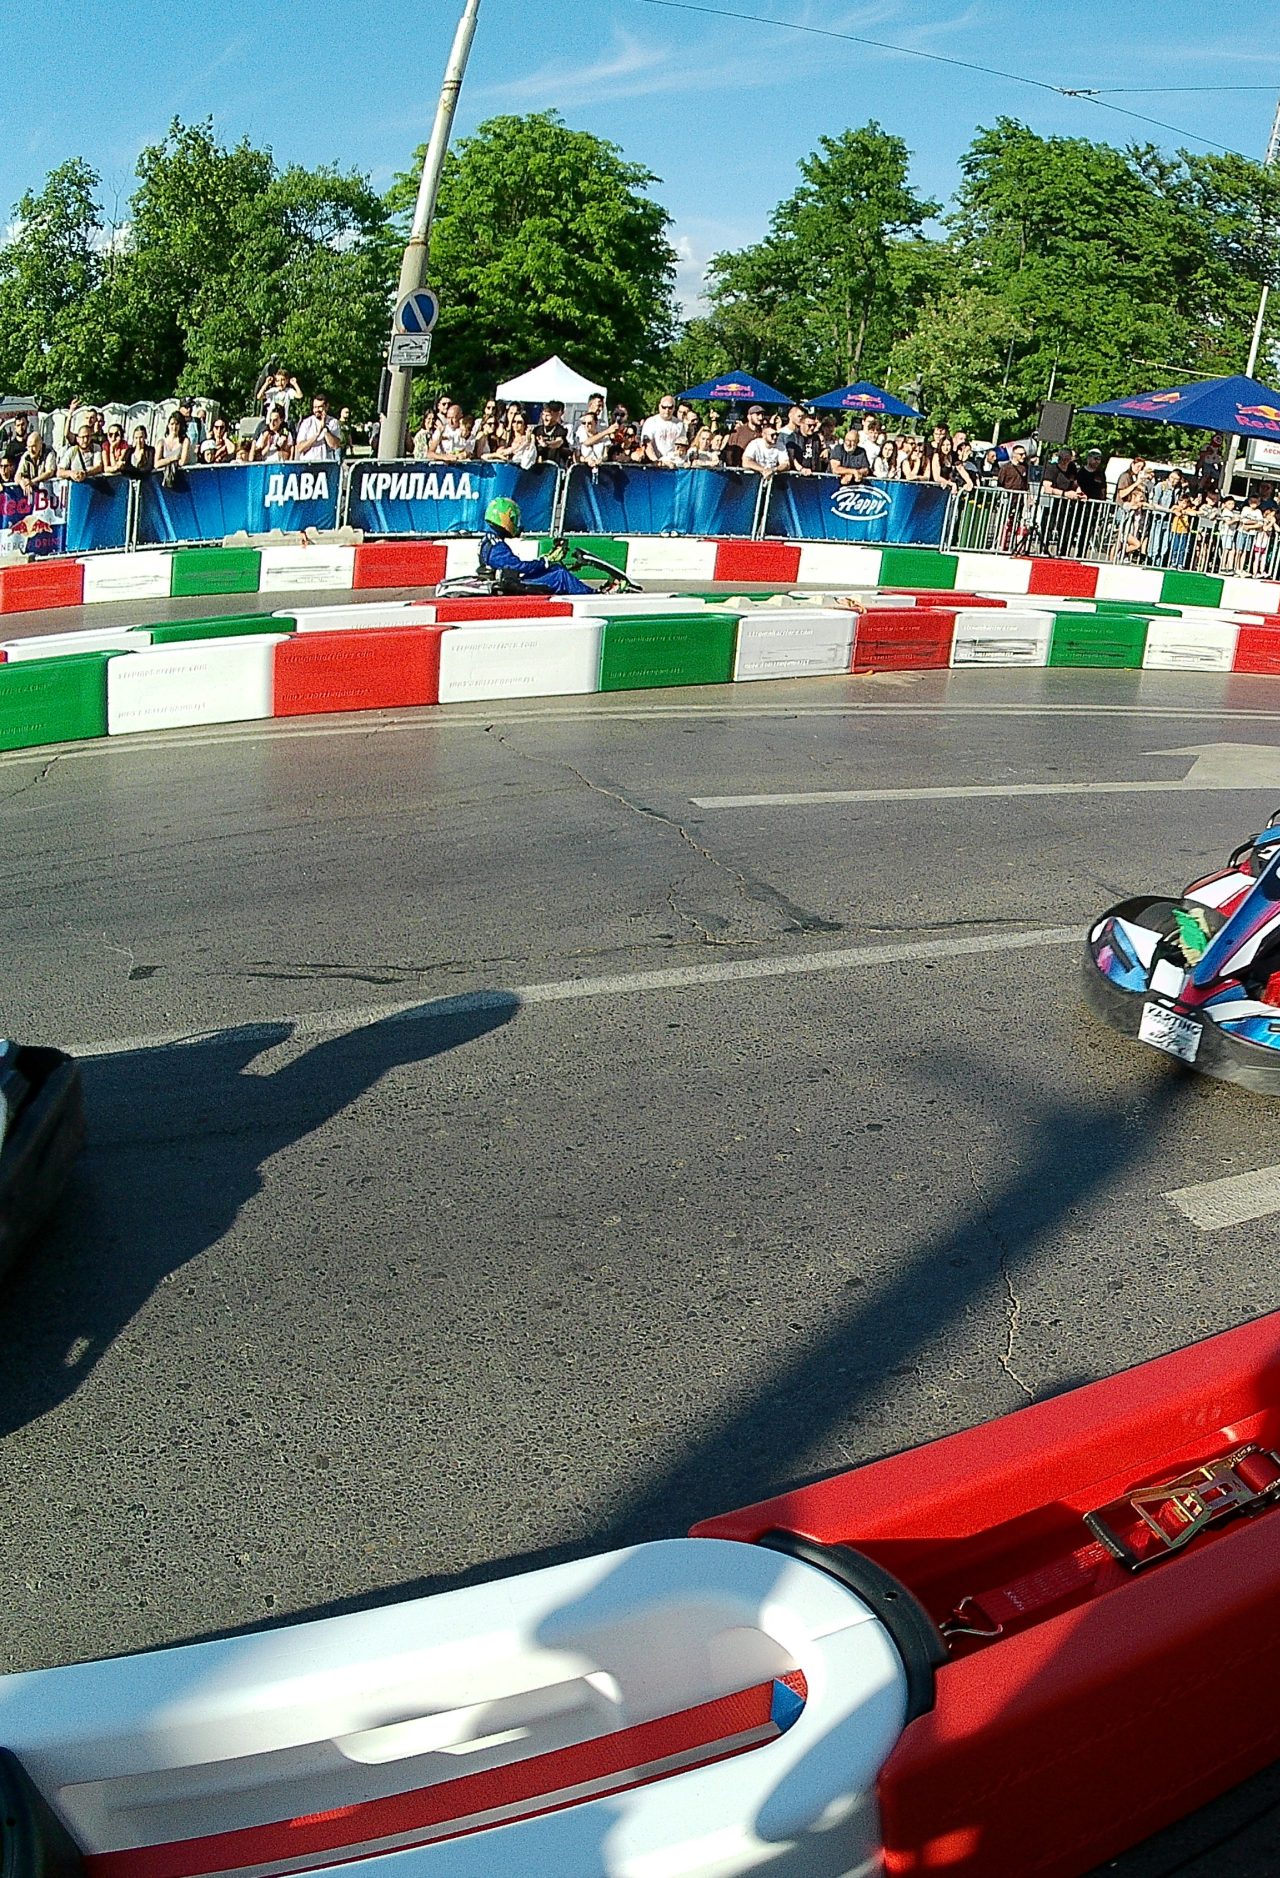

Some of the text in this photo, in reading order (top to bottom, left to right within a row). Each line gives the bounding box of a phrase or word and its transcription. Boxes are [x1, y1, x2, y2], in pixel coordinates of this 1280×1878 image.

[1234, 414, 1275, 432] Red
[264, 472, 330, 507] ДАВА
[360, 472, 480, 500] КРИЛААА.
[836, 491, 887, 515] Happy
